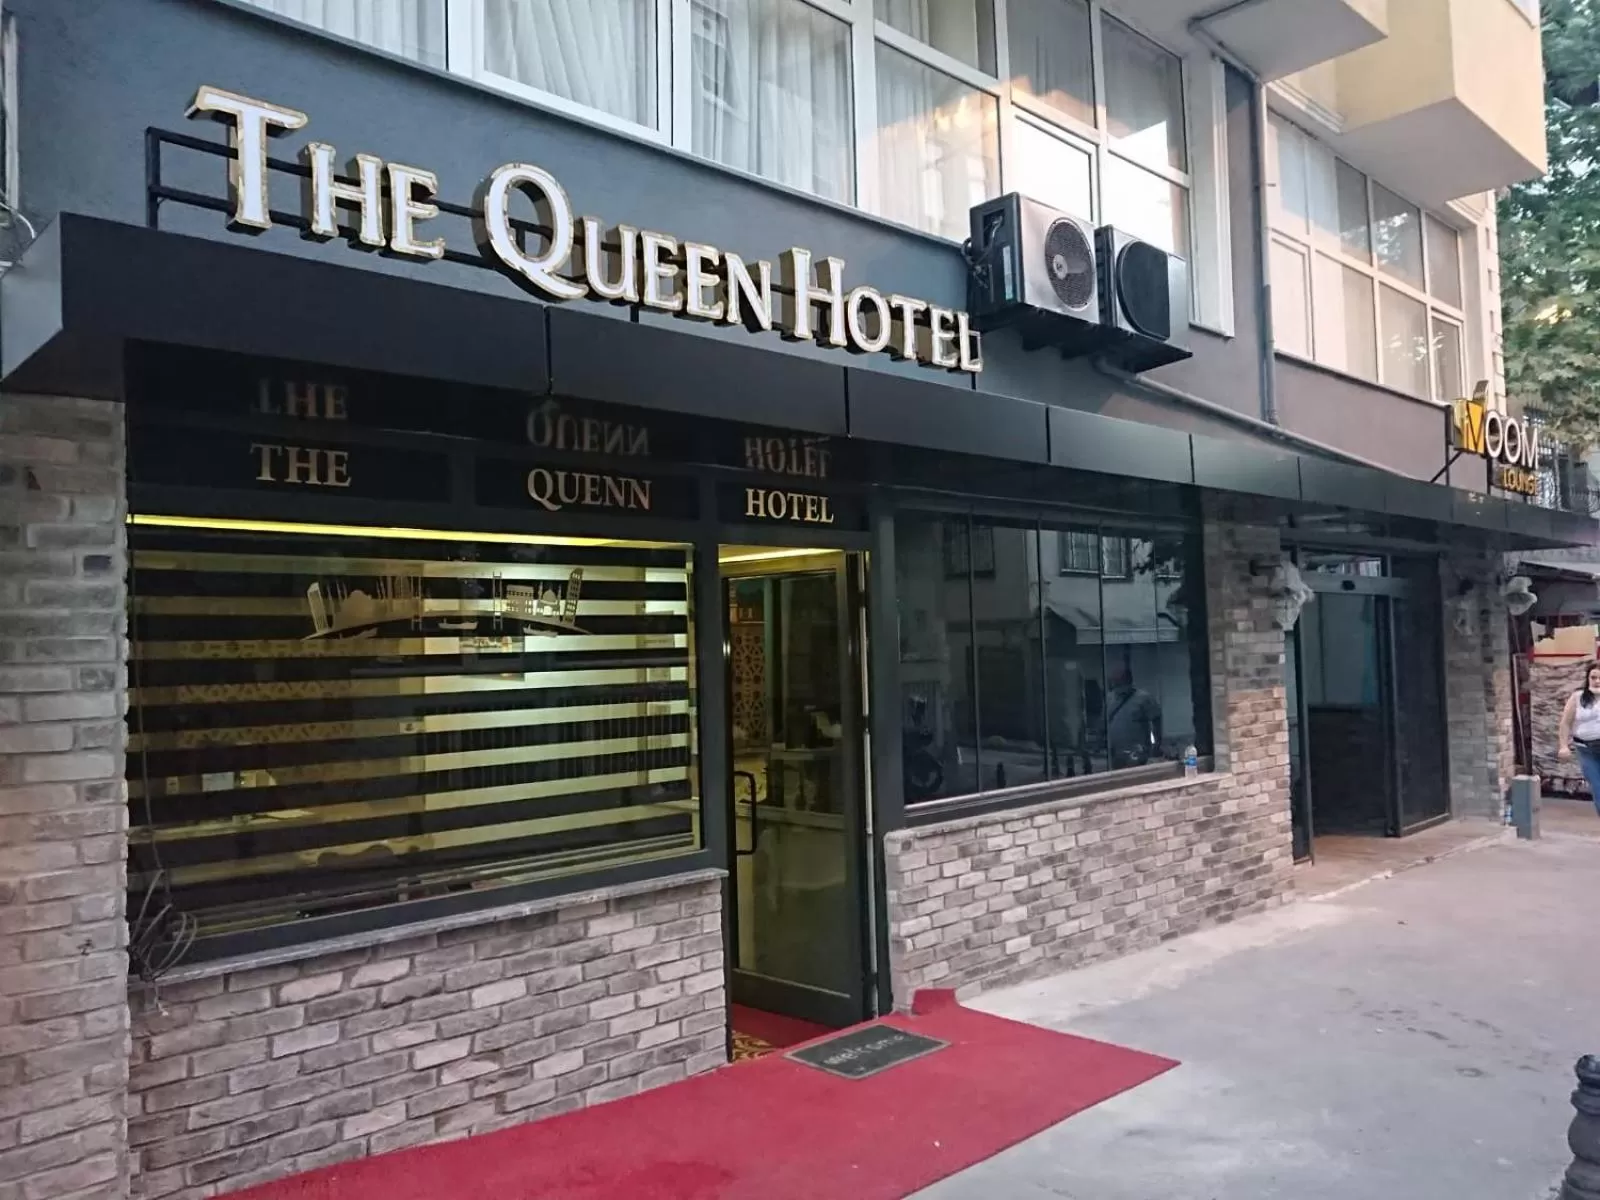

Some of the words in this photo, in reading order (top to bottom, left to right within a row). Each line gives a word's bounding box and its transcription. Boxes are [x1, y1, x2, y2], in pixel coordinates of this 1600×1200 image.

[250, 443, 352, 487] THE
[527, 468, 652, 511] QUENN
[745, 488, 834, 523] HOTEL
